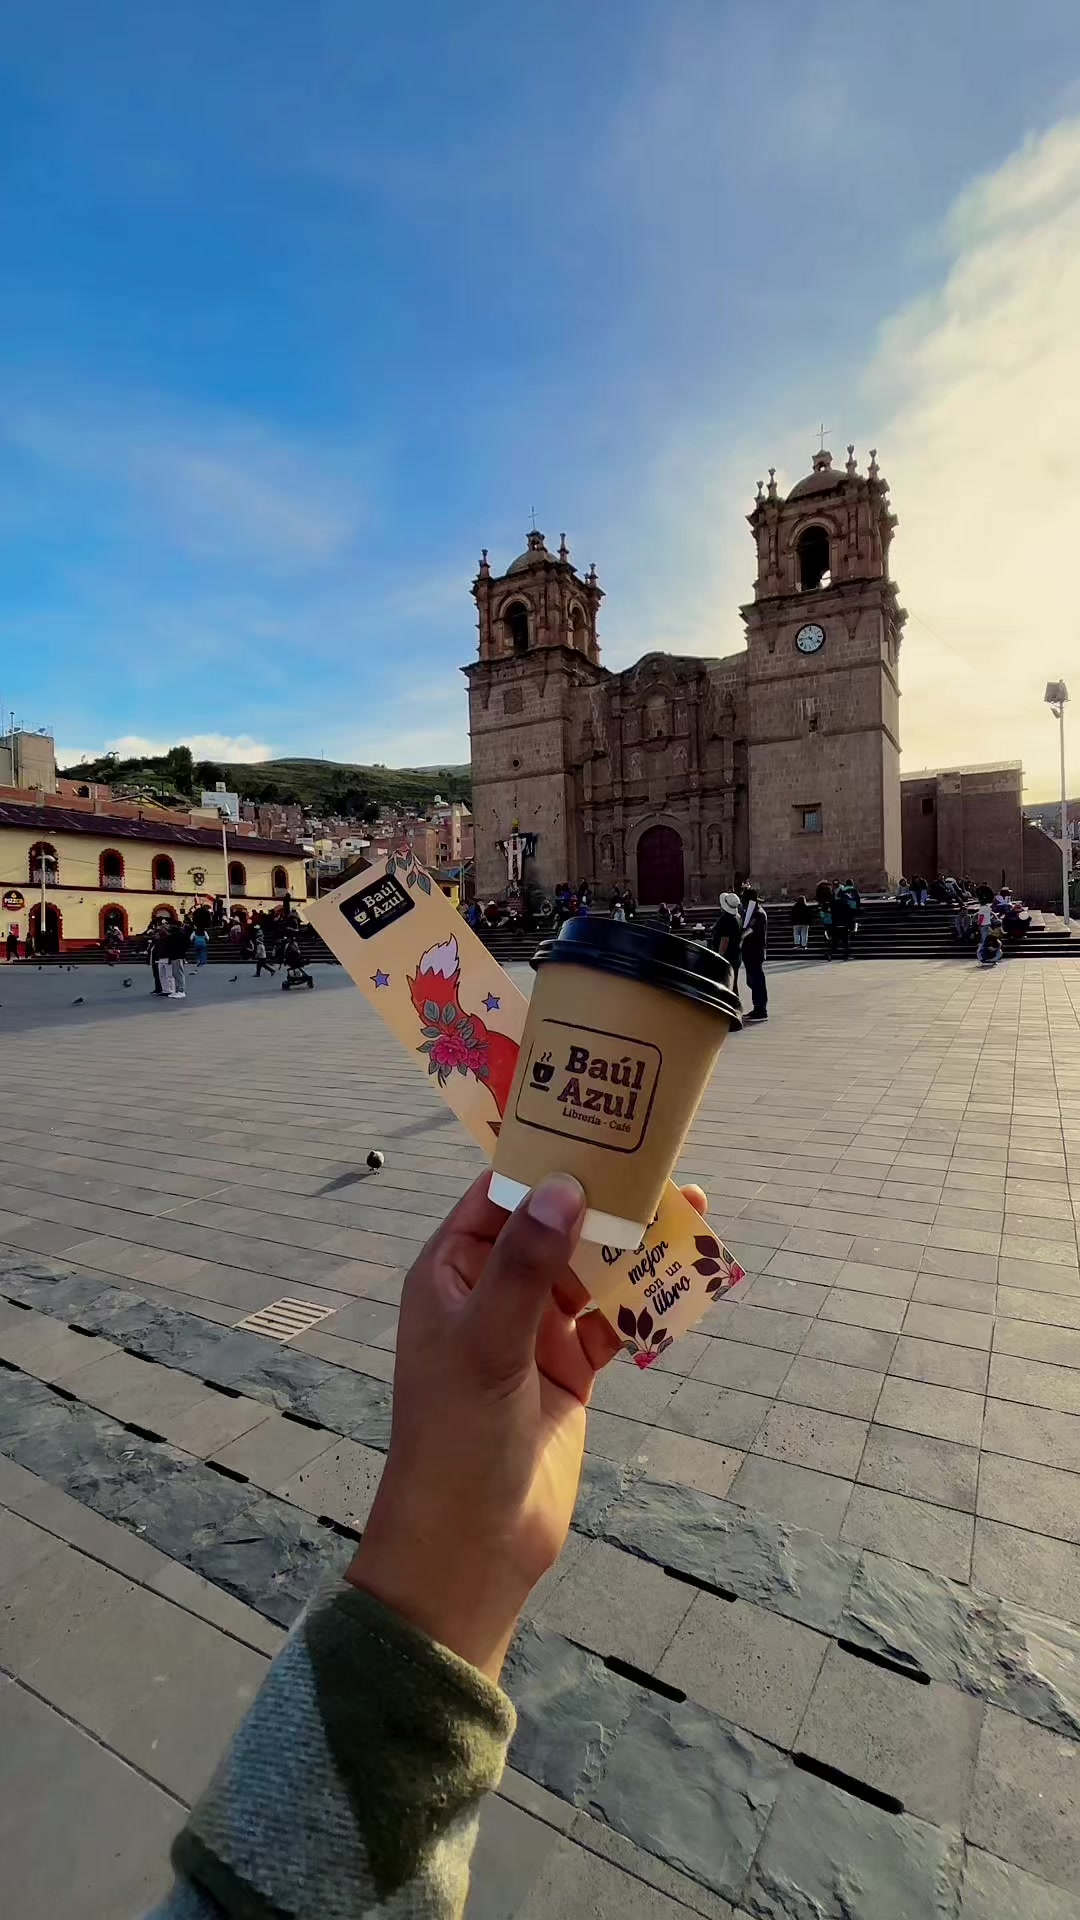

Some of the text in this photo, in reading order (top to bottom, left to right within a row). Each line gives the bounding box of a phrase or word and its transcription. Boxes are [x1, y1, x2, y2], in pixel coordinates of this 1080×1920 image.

[362, 881, 397, 907] Baúl
[373, 891, 404, 918] Azul
[565, 1045, 646, 1090] Baúl
[557, 1077, 638, 1120] Azul
[628, 1240, 669, 1285] mejor
[644, 1260, 683, 1298] con un
[652, 1275, 691, 1316] libro
